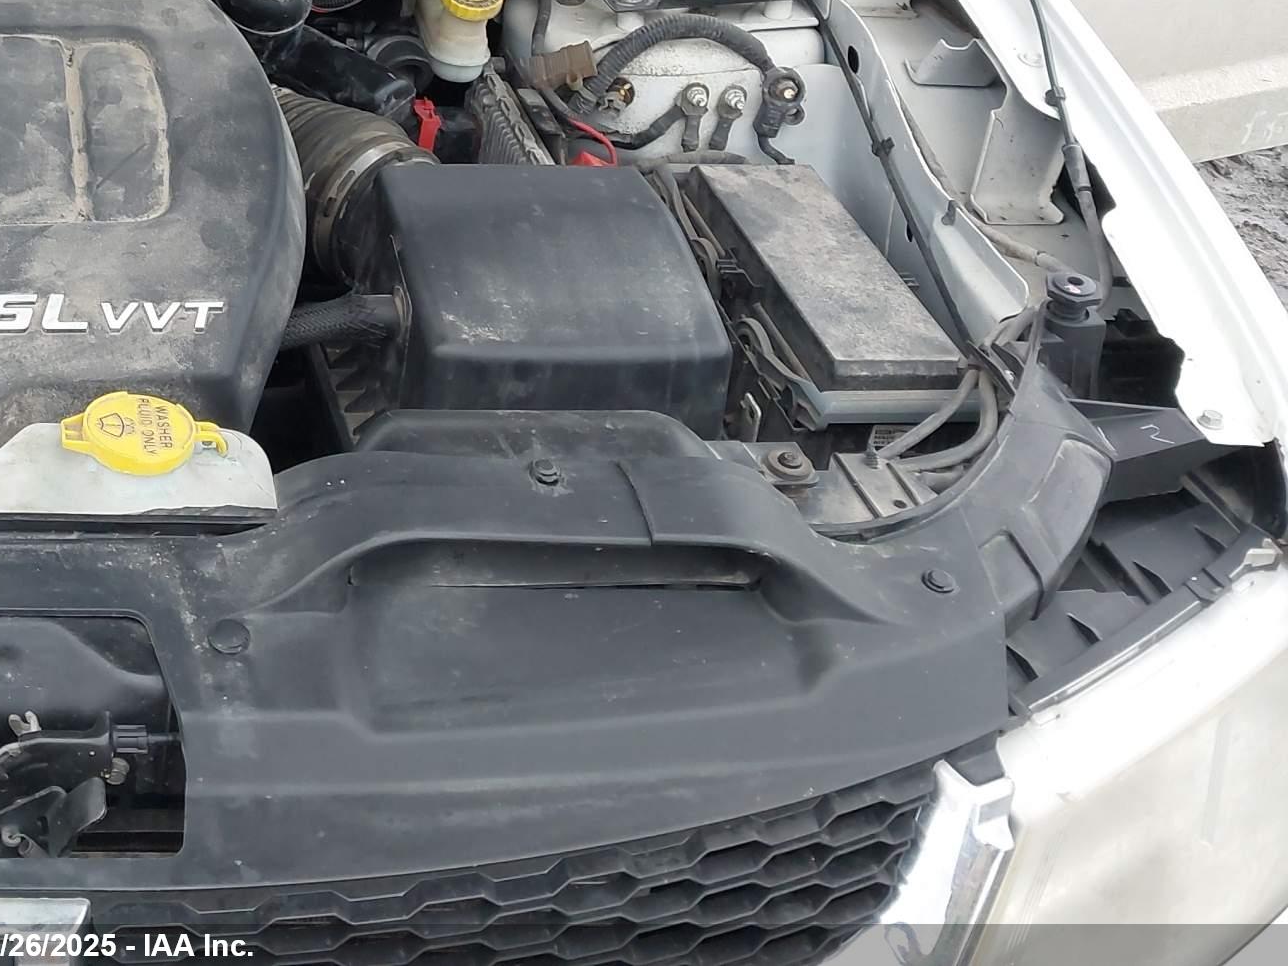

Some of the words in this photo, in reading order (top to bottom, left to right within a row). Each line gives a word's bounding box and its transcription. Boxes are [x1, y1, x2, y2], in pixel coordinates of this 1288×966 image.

[100, 300, 225, 334] VVT
[136, 398, 152, 427] FLUID
[155, 405, 173, 449] WASHER
[142, 429, 158, 455] ONLY
